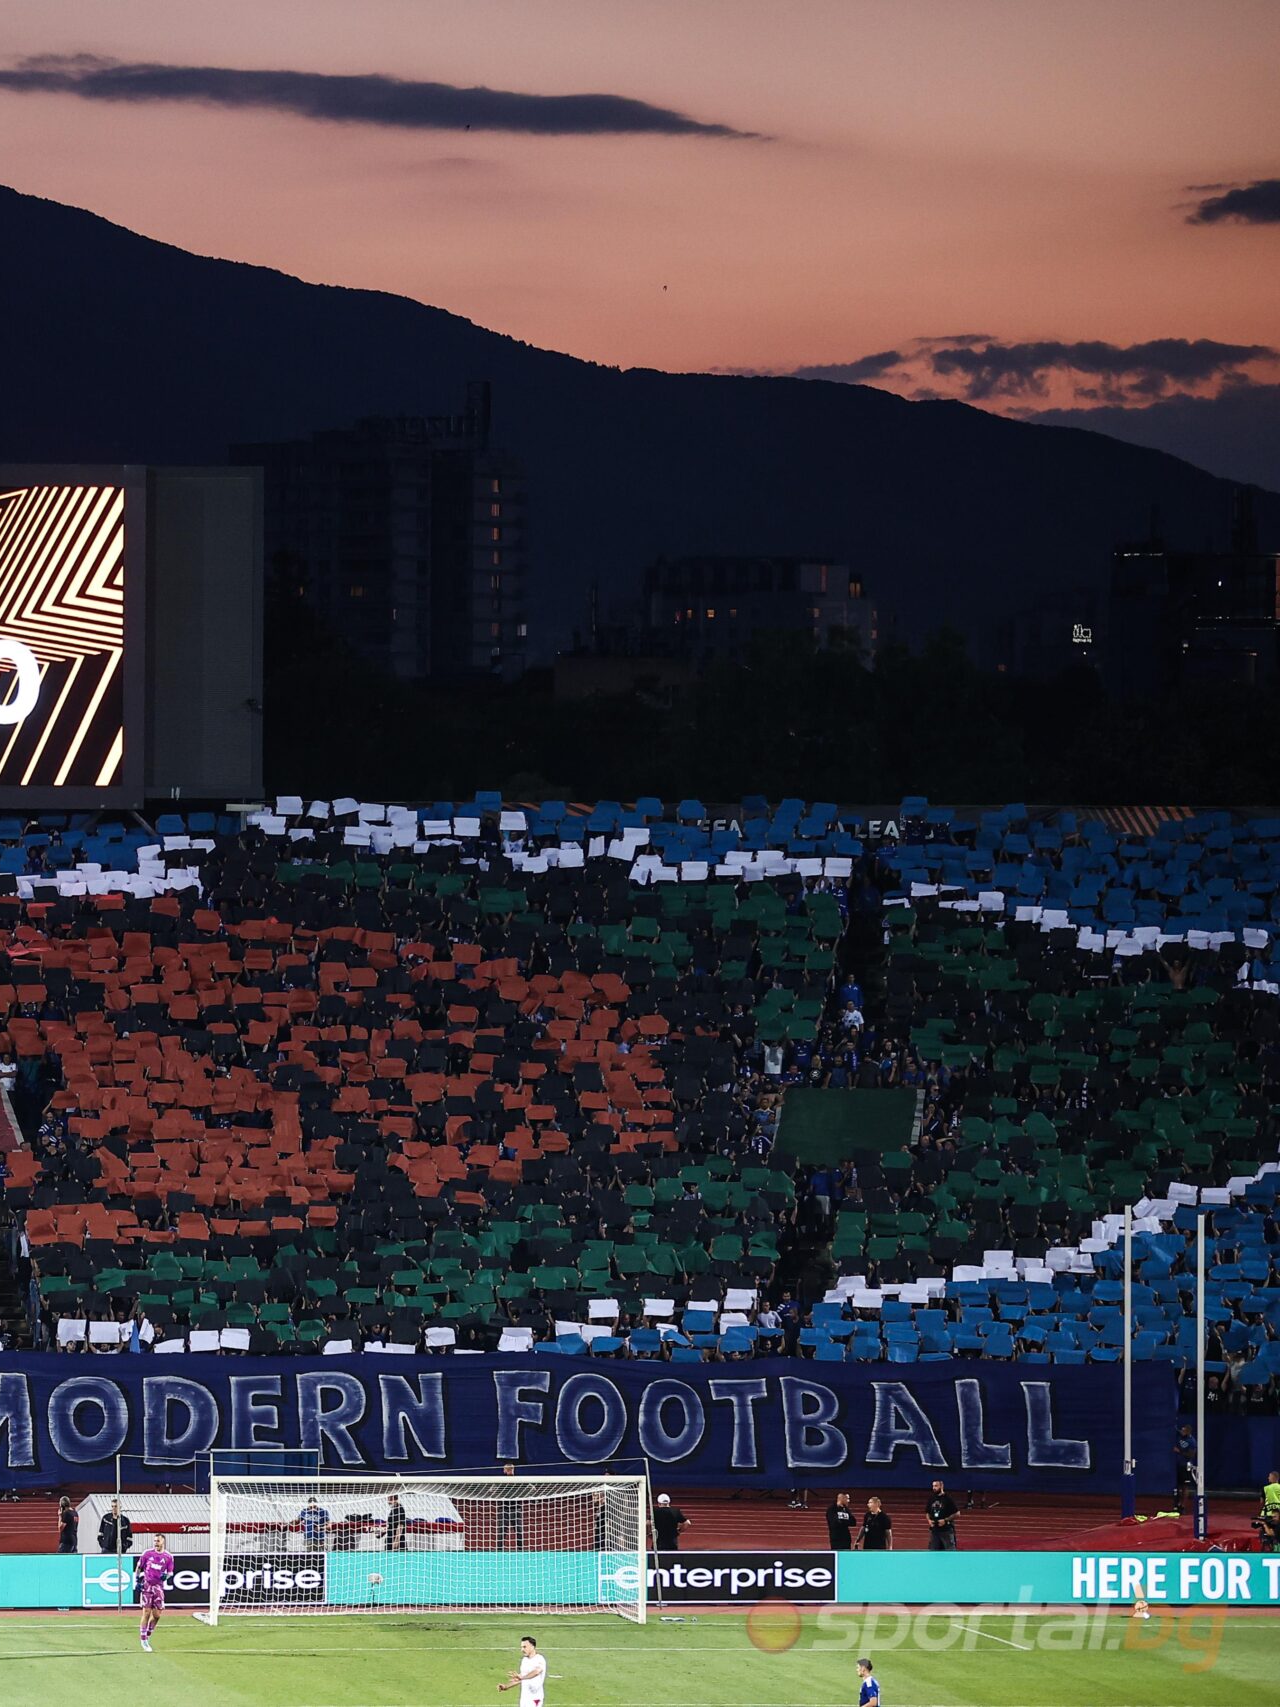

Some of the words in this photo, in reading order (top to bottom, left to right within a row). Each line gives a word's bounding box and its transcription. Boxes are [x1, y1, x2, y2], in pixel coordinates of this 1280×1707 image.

[493, 1370, 1091, 1469] FOOTBALL
[615, 1560, 833, 1595] enterprise
[1072, 1557, 1167, 1599] HERE
[1180, 1557, 1251, 1599] FOR
[1262, 1558, 1280, 1599] T
